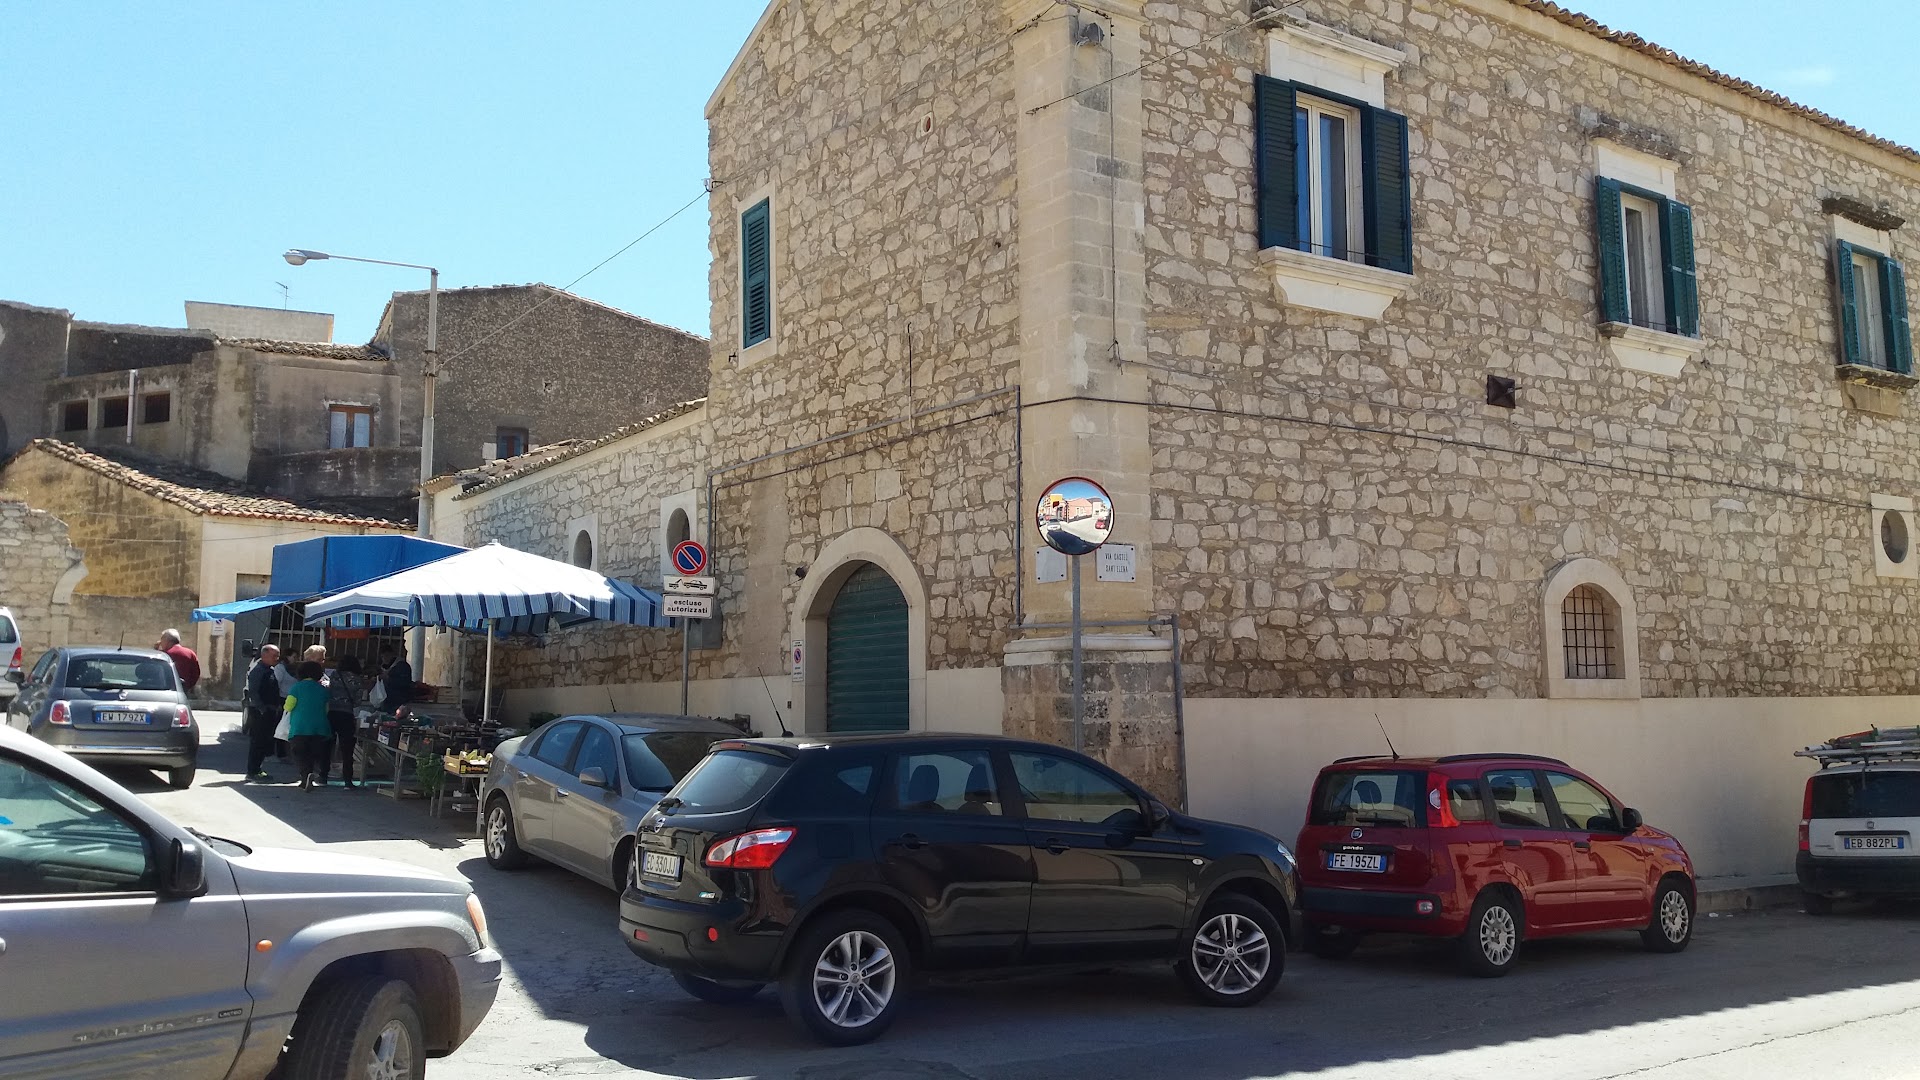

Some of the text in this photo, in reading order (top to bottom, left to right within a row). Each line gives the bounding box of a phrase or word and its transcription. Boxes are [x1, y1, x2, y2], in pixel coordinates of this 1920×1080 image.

[102, 712, 114, 721] EW
[1851, 838, 1897, 848] EB 882PL
[1334, 854, 1379, 869] FE 195ZL
